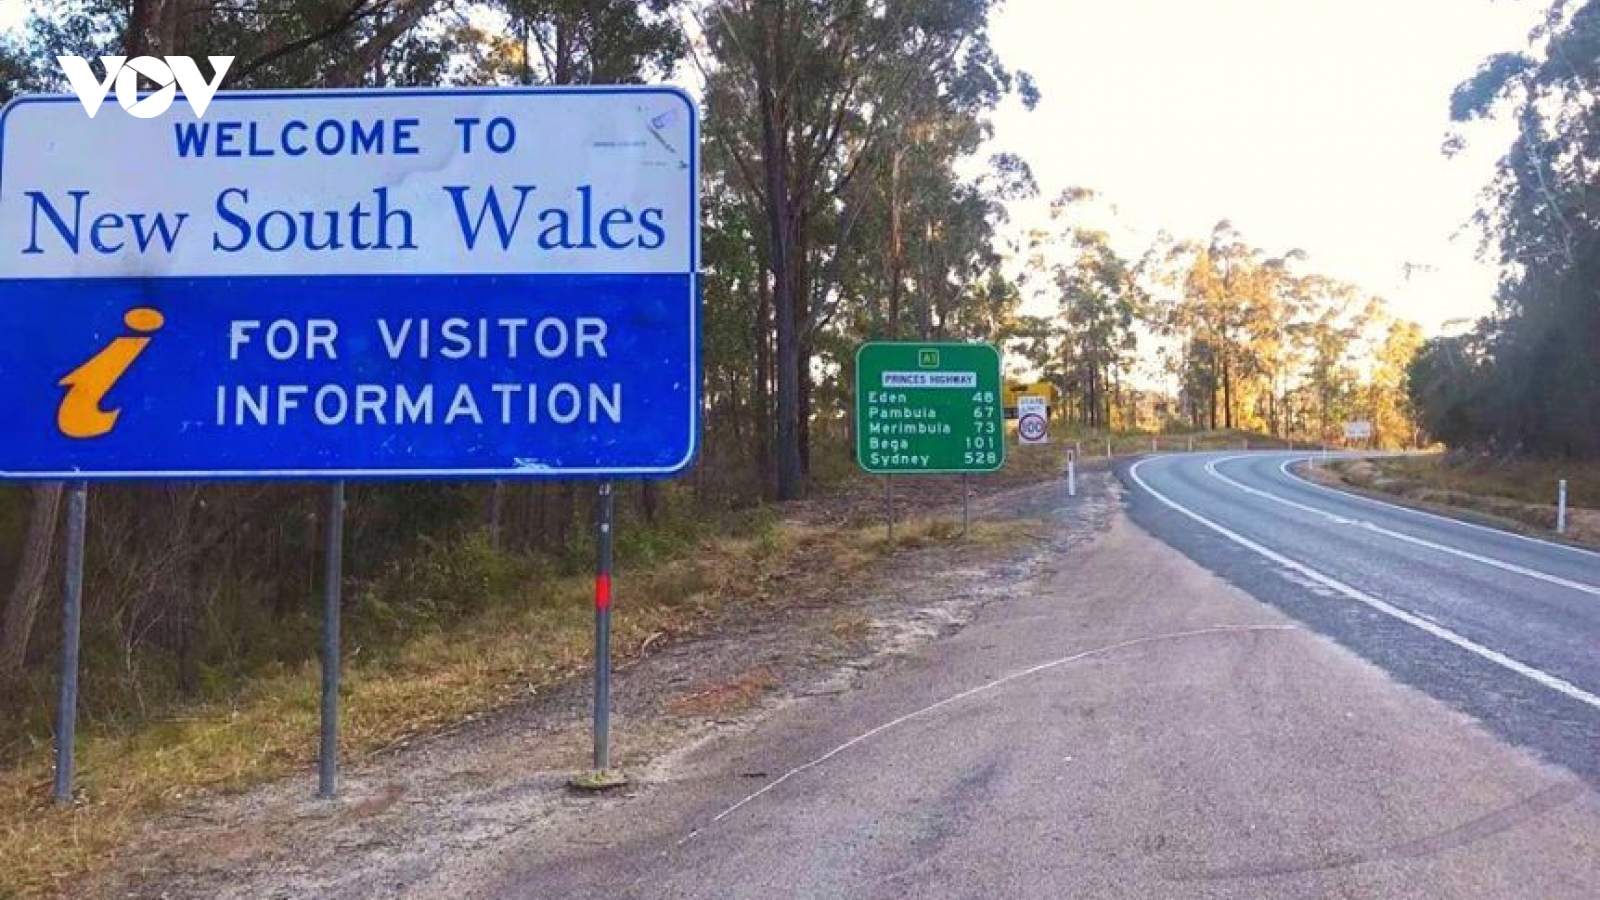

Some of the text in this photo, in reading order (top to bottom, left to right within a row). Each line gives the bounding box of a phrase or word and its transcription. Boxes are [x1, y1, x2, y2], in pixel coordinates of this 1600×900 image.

[175, 117, 516, 157] WELCOME TO
[22, 185, 666, 255] New South Wales
[230, 317, 609, 360] FOR VISITOR
[884, 374, 973, 384] PRINCES HIGHWAY
[868, 391, 994, 403] Eden 48
[216, 383, 622, 426] INFORMATION
[868, 407, 995, 419] Pambula 67
[869, 422, 996, 434] Merimbula 73
[869, 437, 995, 451] Bega 101
[870, 452, 996, 467] Sydney 528
